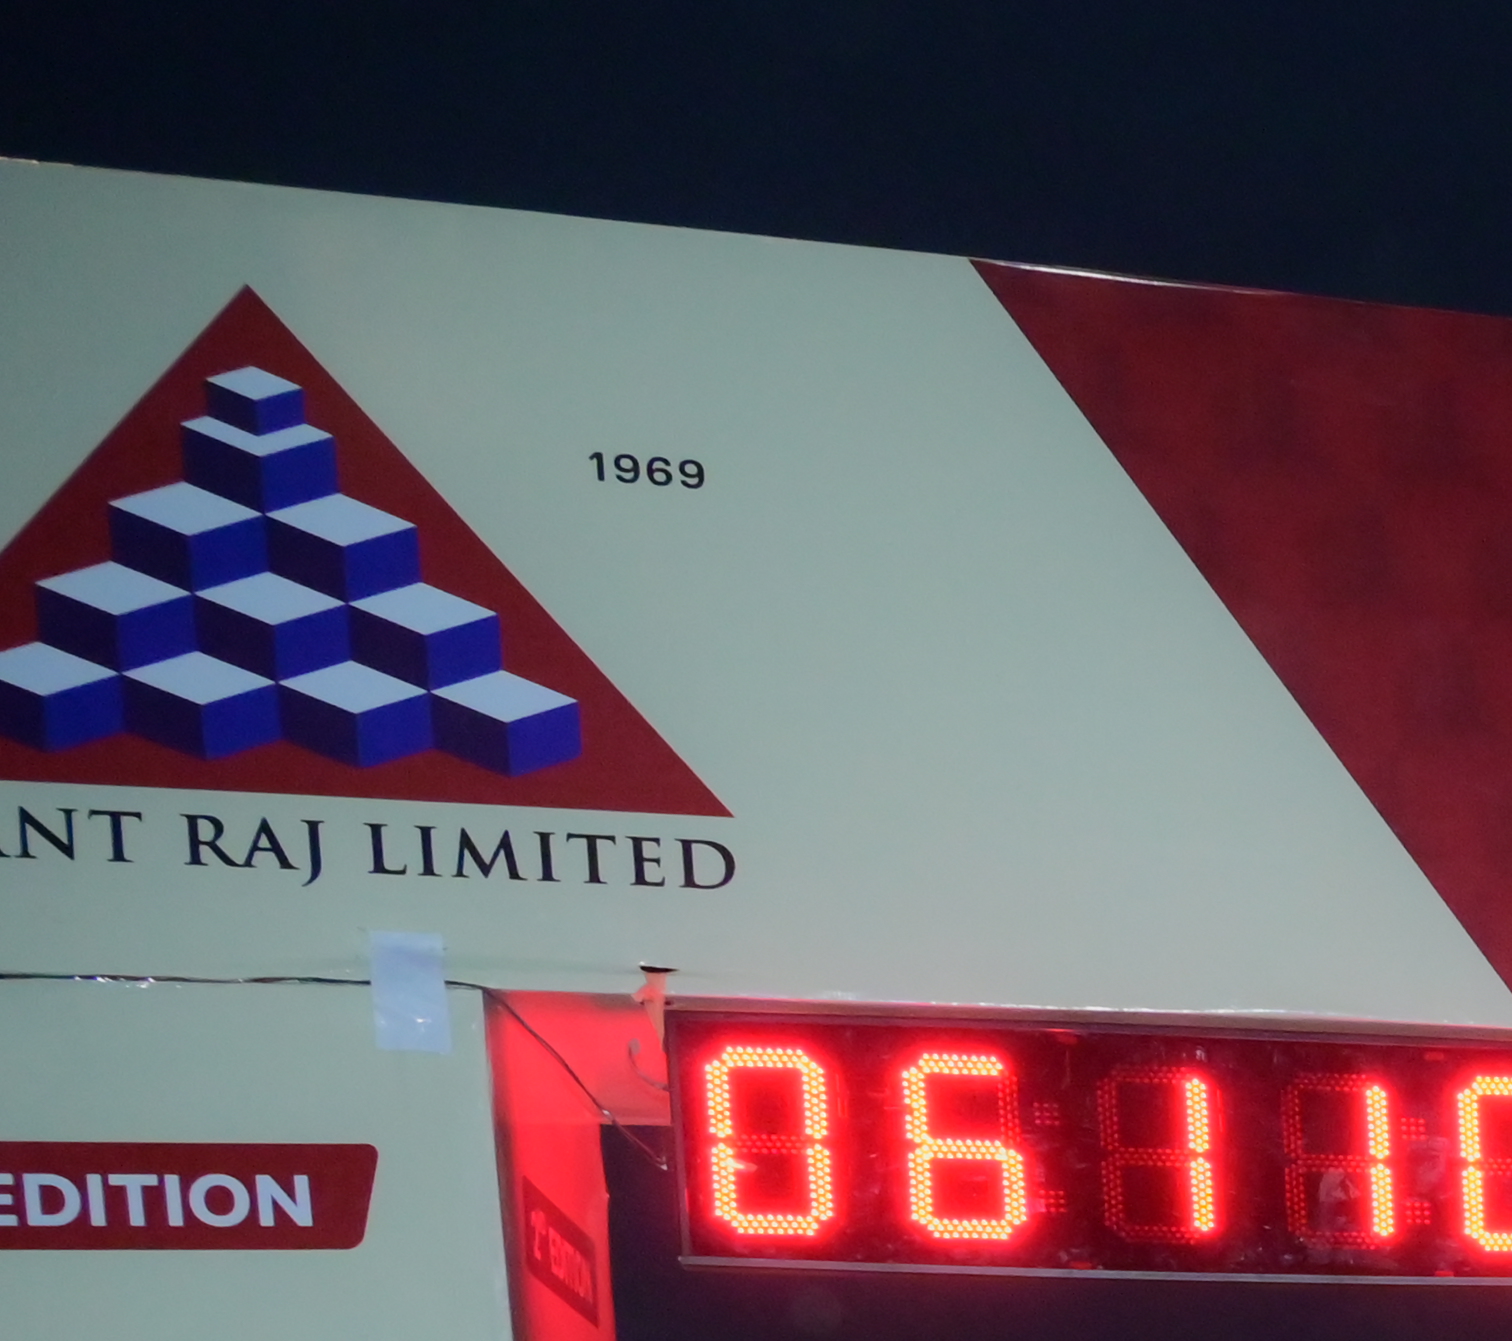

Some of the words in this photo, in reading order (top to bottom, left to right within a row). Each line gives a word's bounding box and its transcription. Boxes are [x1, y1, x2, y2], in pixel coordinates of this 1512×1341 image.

[588, 450, 706, 489] 1969
[181, 813, 326, 888] RAJ
[367, 824, 737, 891] LIMITED
